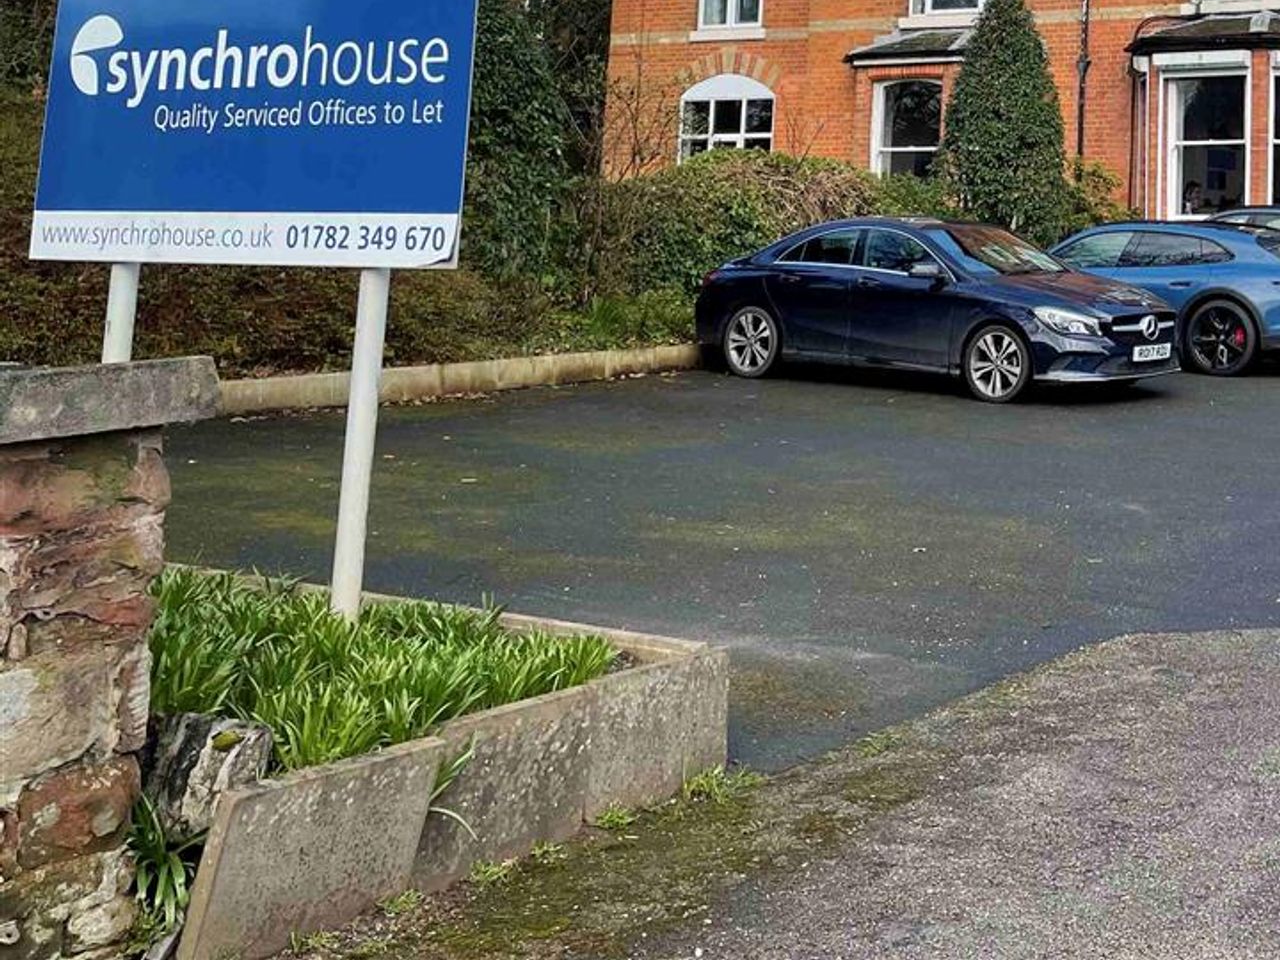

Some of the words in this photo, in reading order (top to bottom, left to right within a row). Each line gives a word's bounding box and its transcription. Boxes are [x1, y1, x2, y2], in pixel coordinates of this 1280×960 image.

[105, 25, 449, 108] synchrohouse
[154, 104, 218, 134] Quality
[224, 100, 301, 128] Serviced
[308, 98, 377, 126] Offices
[384, 103, 405, 124] to
[412, 98, 444, 124] Let
[42, 221, 273, 251] www.synchrohouse.co.uk
[286, 225, 352, 250] 01782
[357, 226, 397, 251] 349
[405, 226, 445, 251] 670
